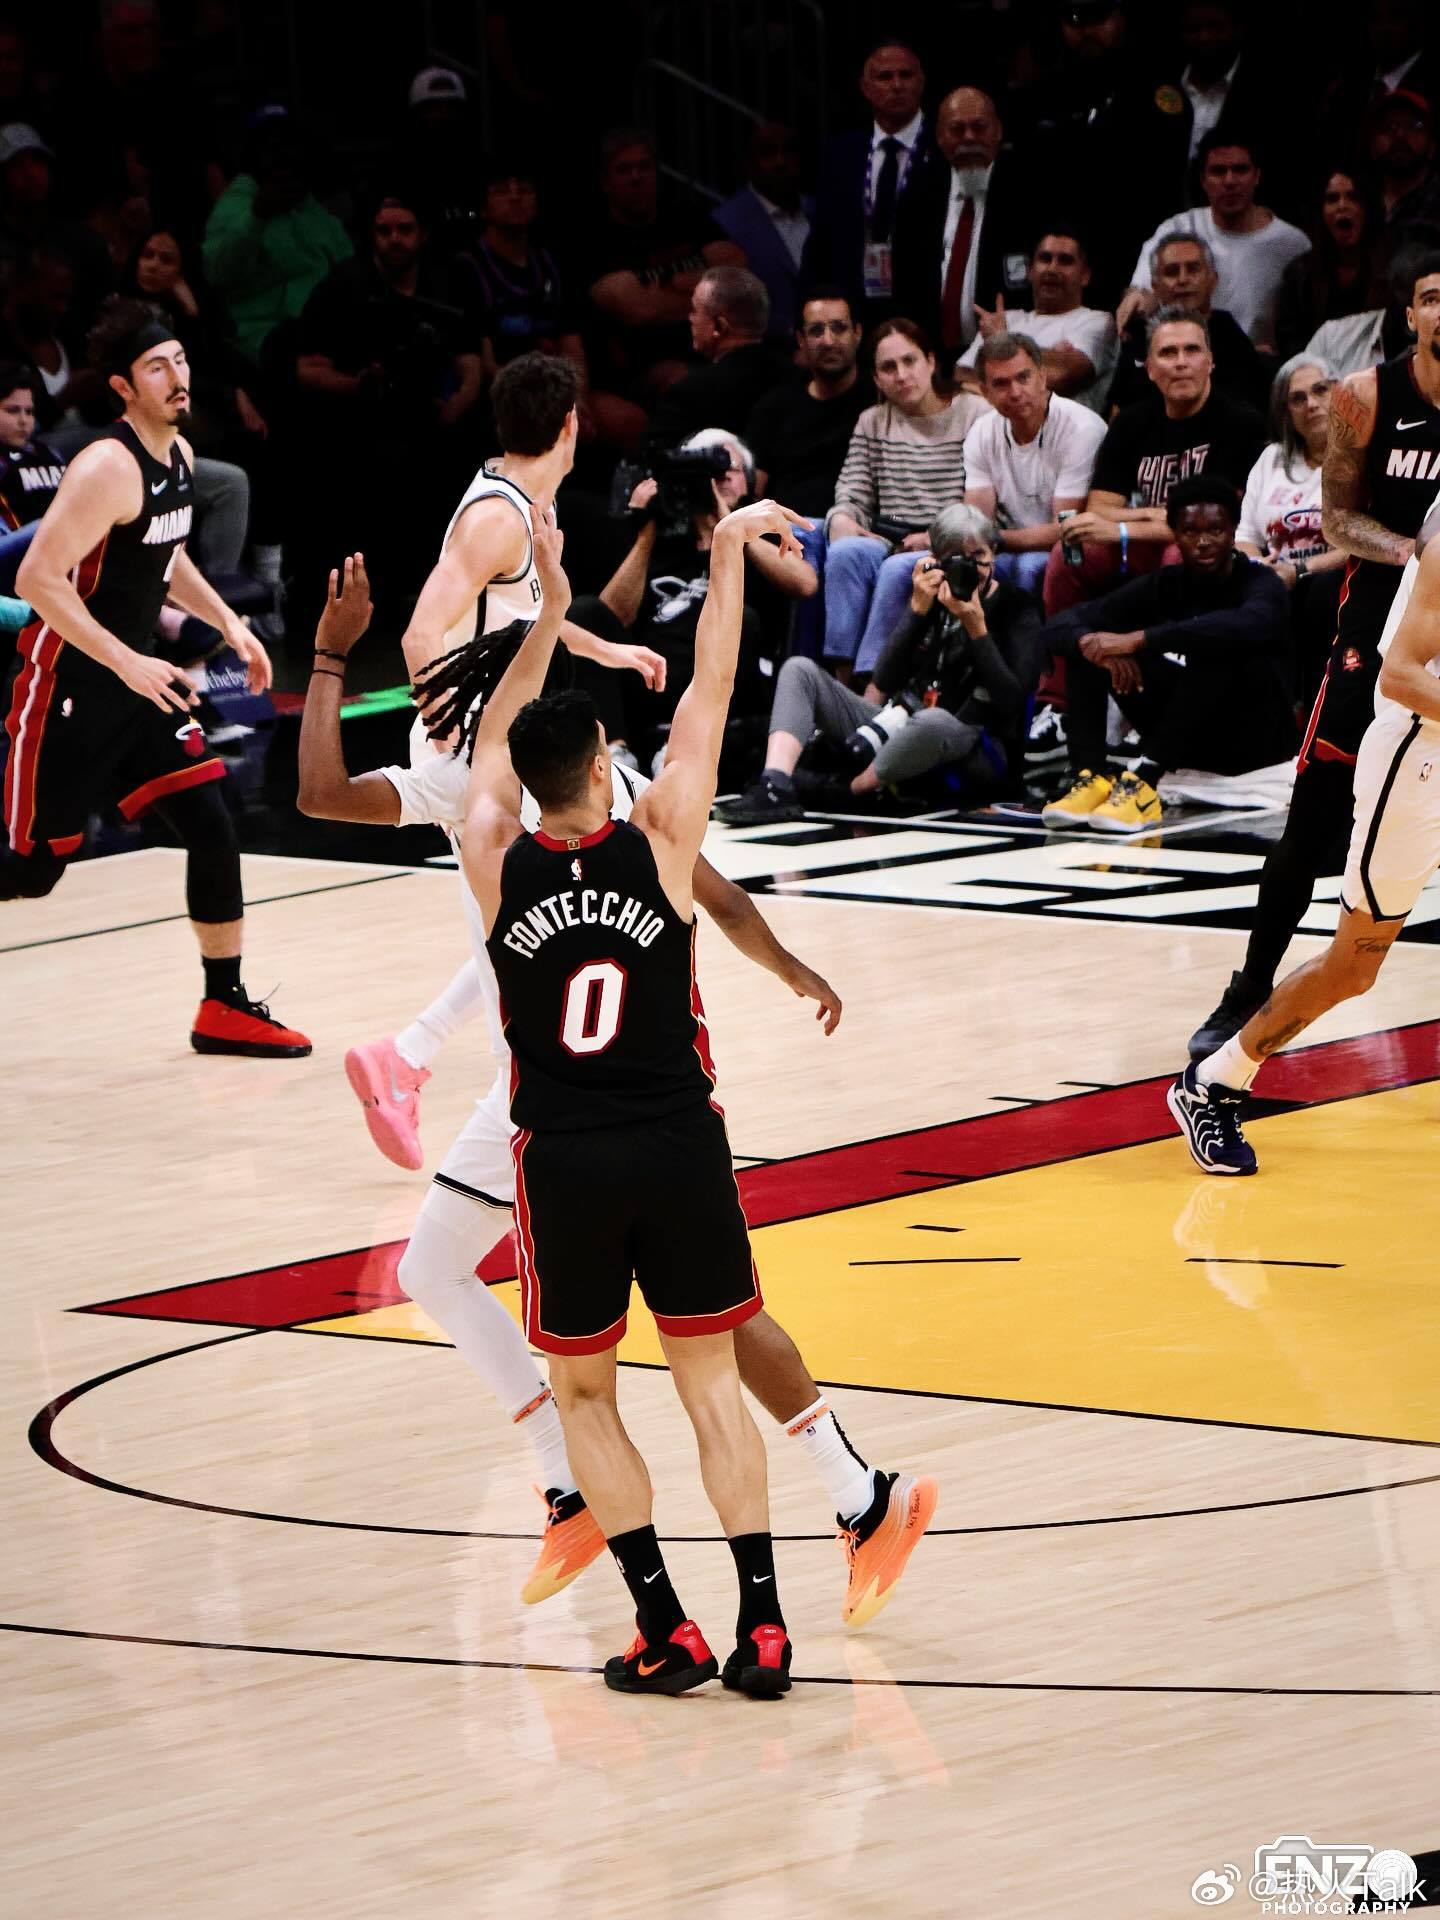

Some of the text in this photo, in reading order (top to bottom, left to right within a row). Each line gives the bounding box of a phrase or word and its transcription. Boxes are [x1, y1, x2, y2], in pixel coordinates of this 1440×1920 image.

[18, 465, 67, 491] MIA
[1386, 449, 1440, 480] MIA
[503, 889, 665, 959] FONTECCHIO
[559, 957, 628, 1057] 0
